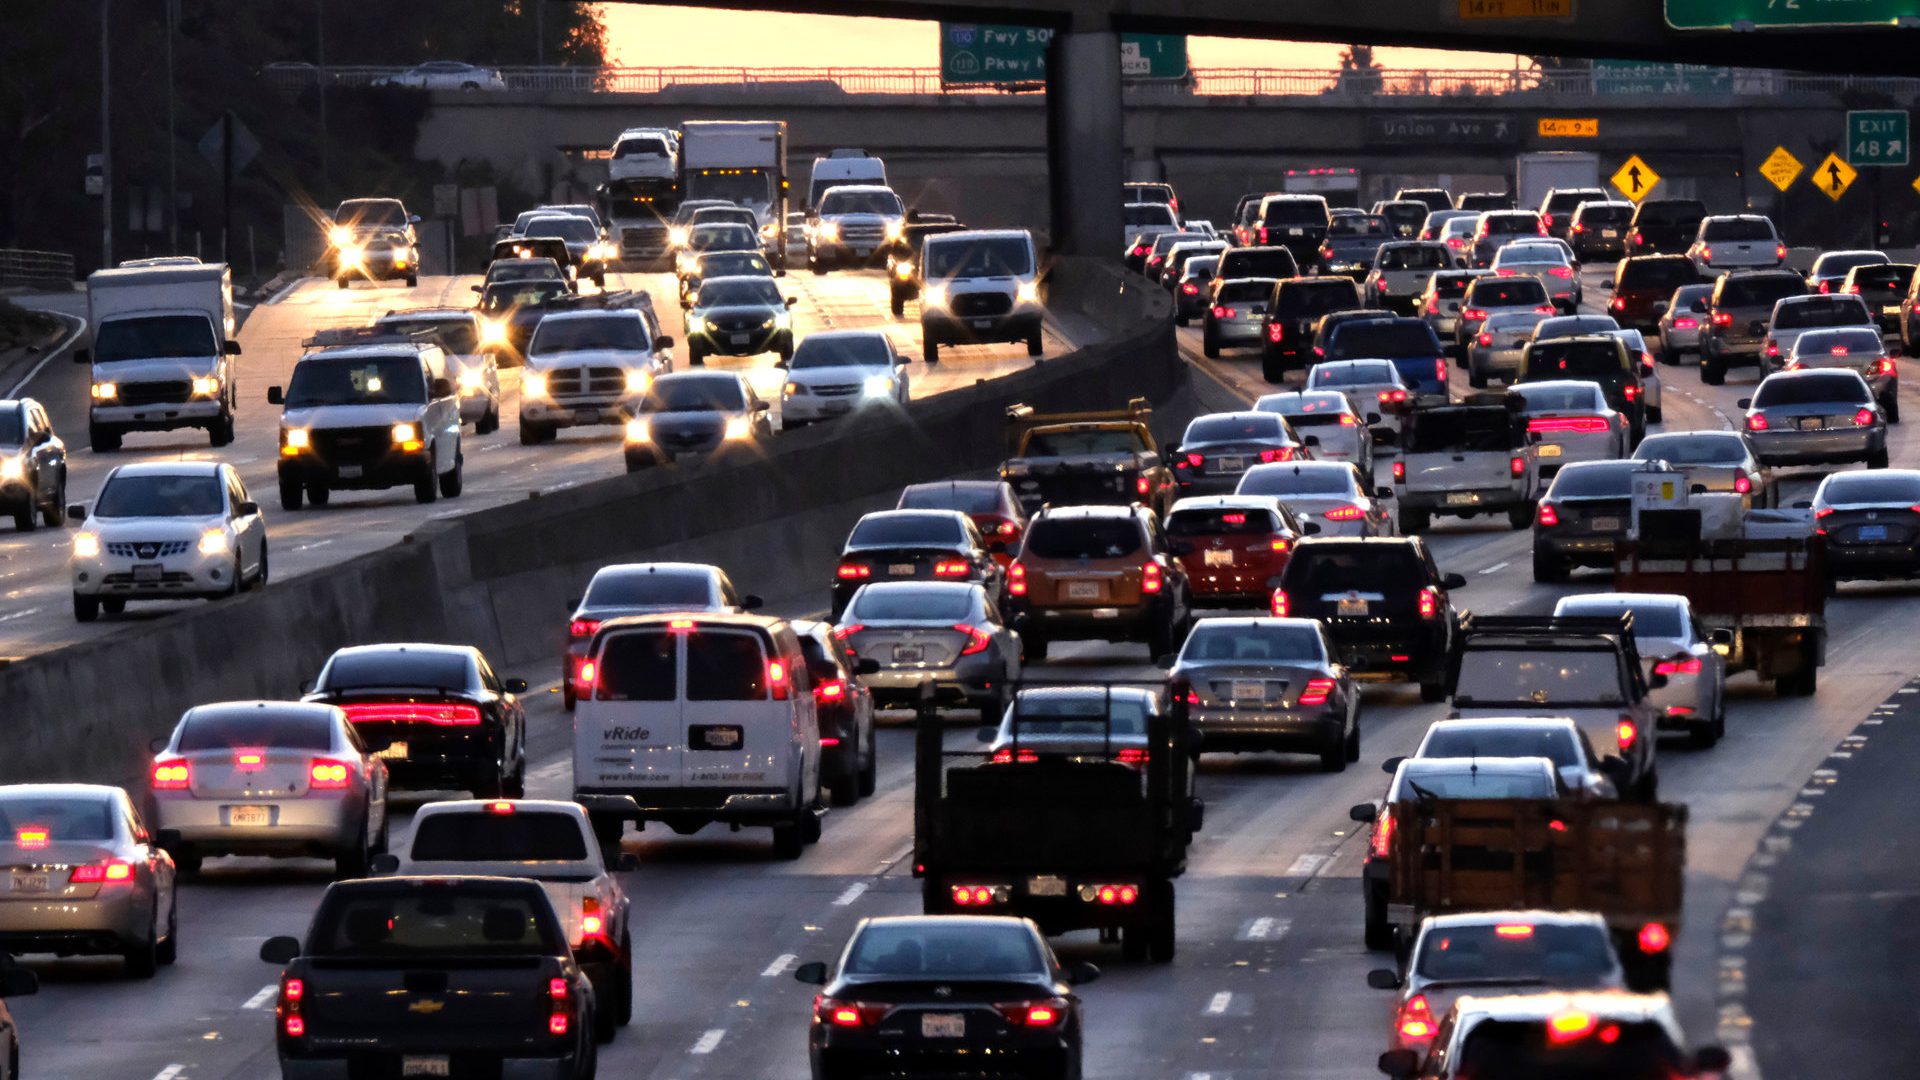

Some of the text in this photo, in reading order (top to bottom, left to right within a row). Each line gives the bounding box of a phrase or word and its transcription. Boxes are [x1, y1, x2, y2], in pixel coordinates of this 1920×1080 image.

[984, 30, 1019, 46] Fwy
[984, 56, 1030, 71] Pkwy
[1384, 120, 1481, 136] Union Ave
[1543, 122, 1556, 132] 14
[1574, 122, 1581, 132] 9
[1859, 119, 1896, 133] EXIT
[1855, 140, 1880, 156] 4B
[603, 726, 650, 741] vRide
